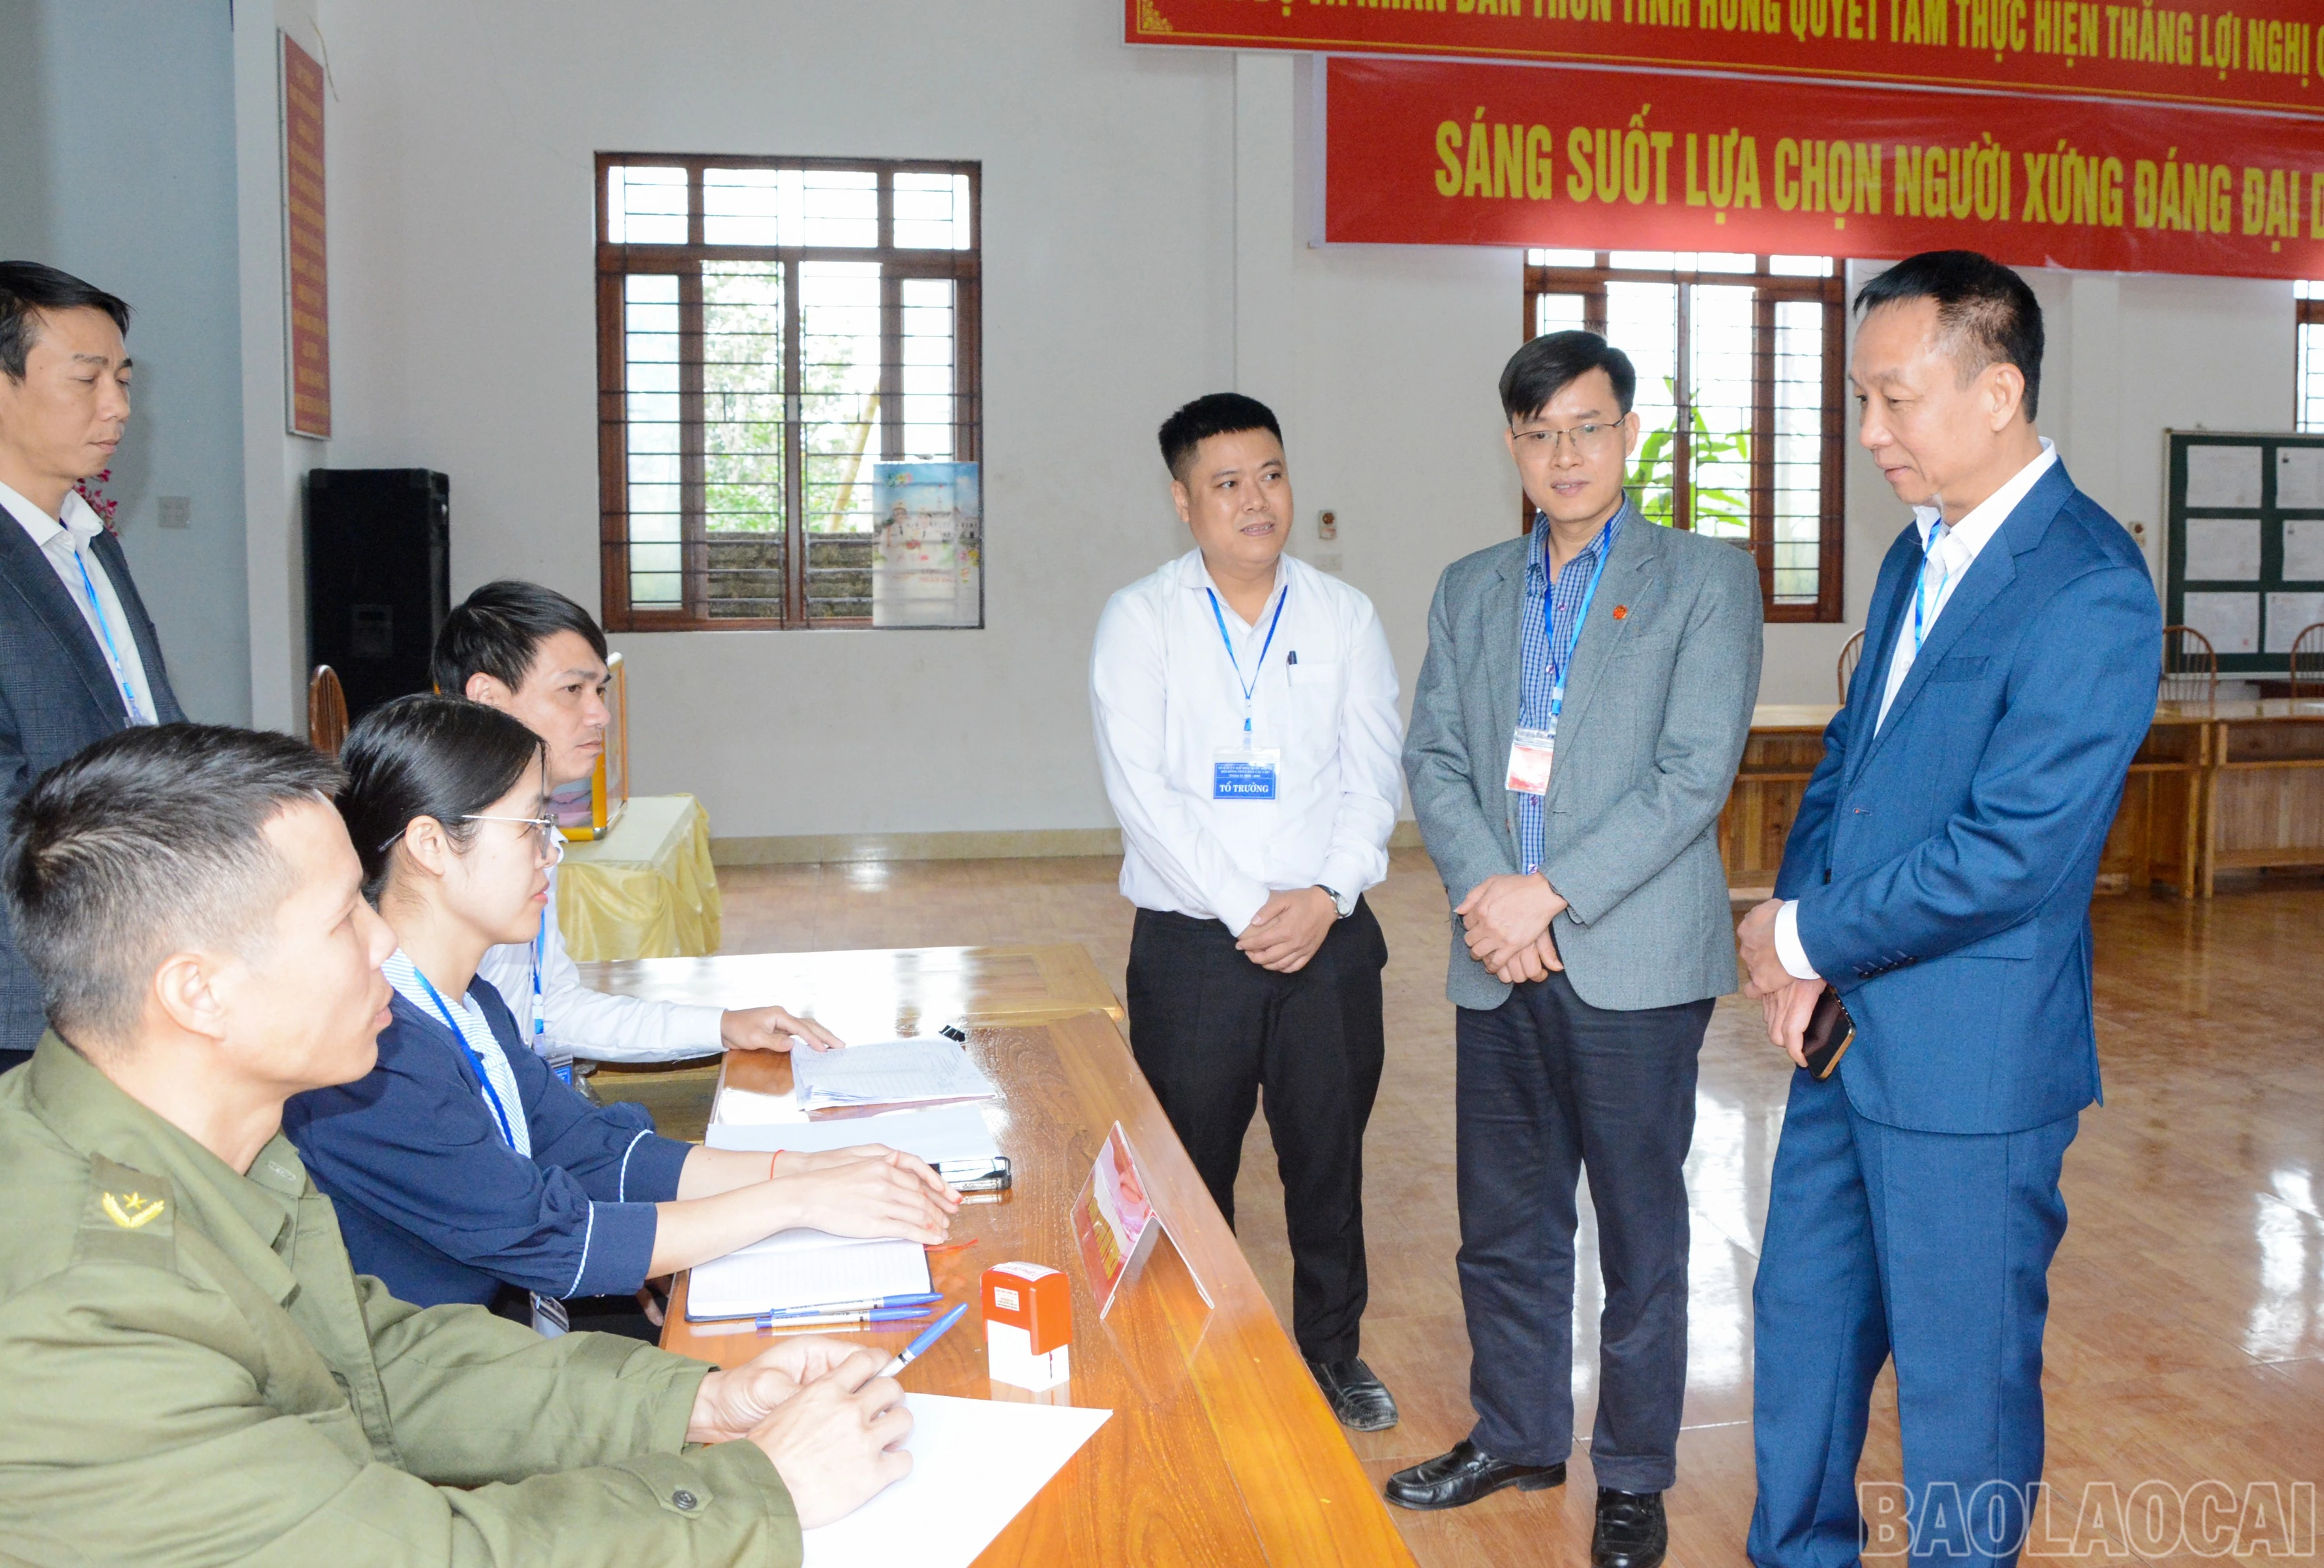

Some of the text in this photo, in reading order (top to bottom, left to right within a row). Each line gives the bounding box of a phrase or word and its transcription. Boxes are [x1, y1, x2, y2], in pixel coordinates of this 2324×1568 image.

[2200, 11, 2241, 81] LỢI
[2248, 18, 2310, 88] NGHỊ
[1435, 106, 1553, 201] SÁNG
[1567, 103, 1673, 205] SUỐT
[1686, 127, 1762, 224] LỰA
[1774, 137, 1882, 230] CHỌN
[1893, 131, 2011, 221] NGƯỜI
[2021, 139, 2124, 227] XỨNG
[2133, 146, 2232, 234] ĐÁNG
[2241, 167, 2301, 253] ĐẠI
[1219, 780, 1269, 793] TỔ TRƯỞNG
